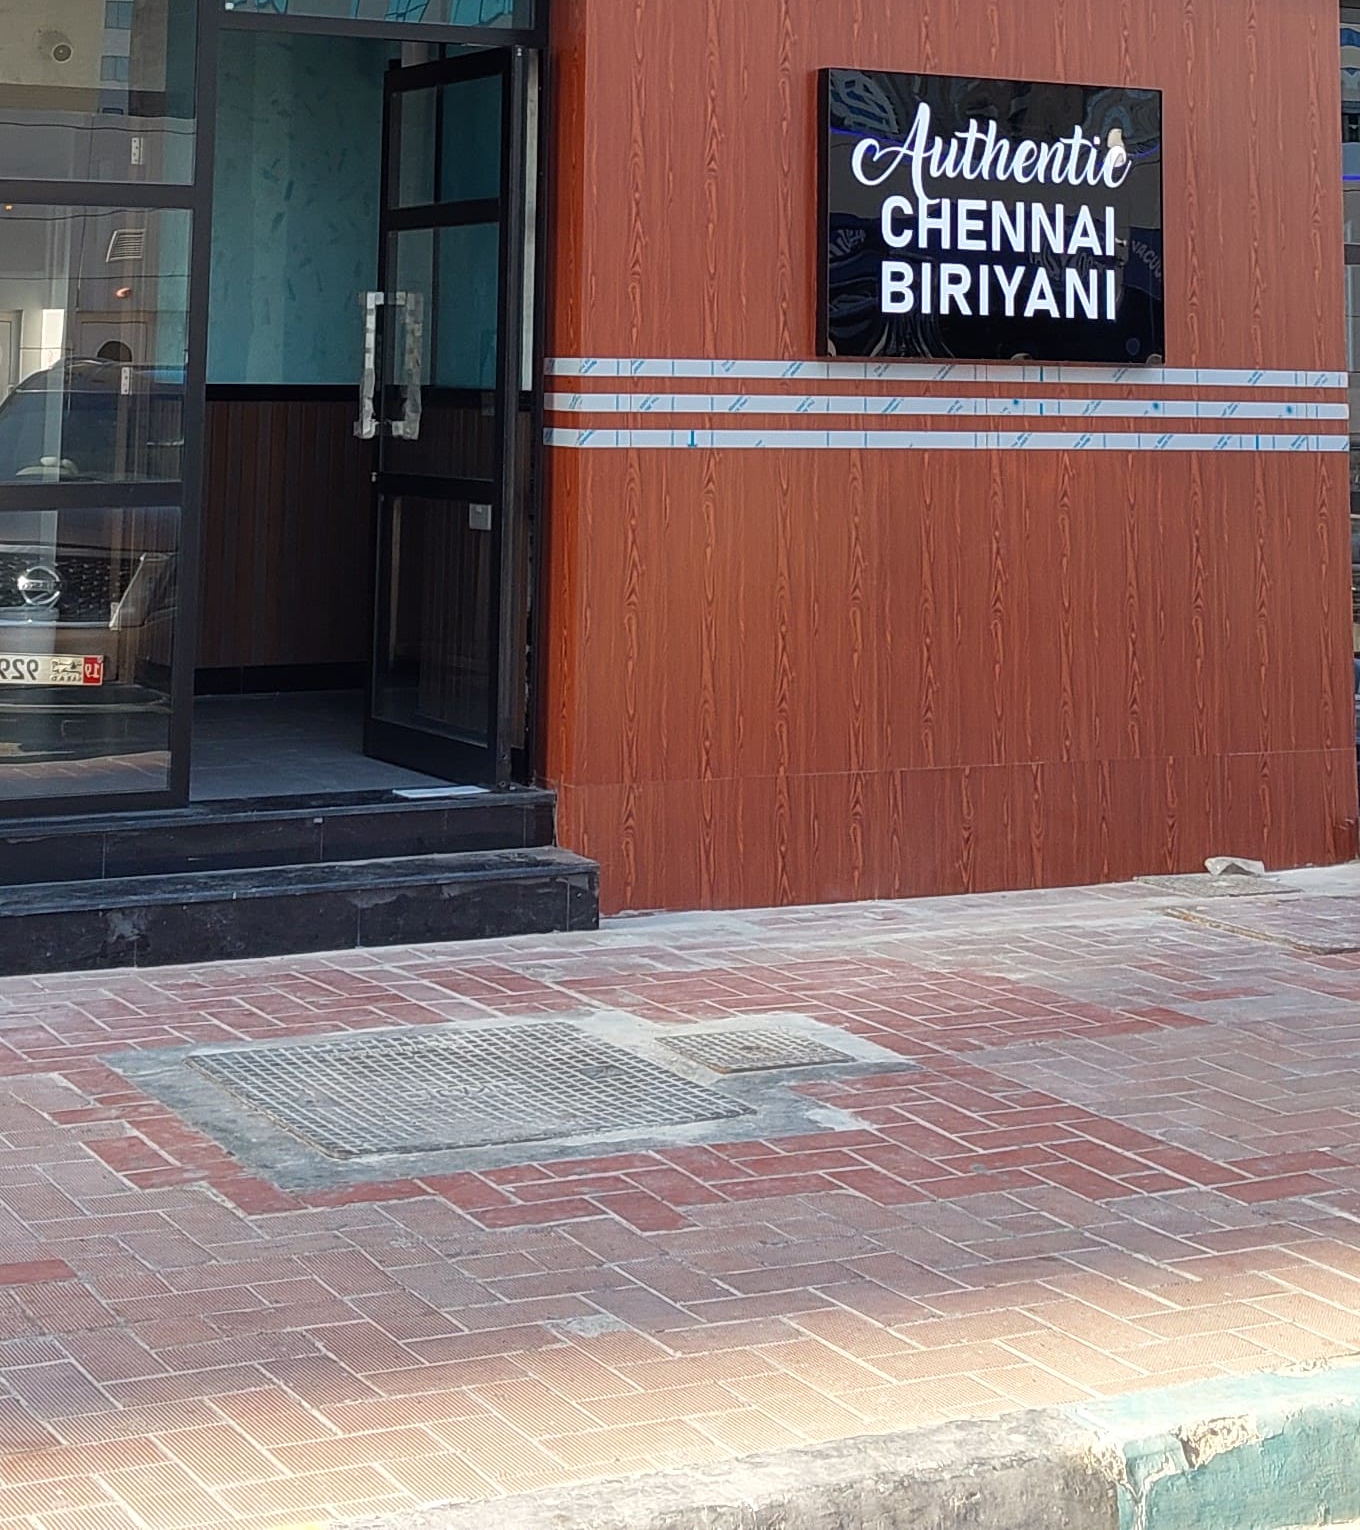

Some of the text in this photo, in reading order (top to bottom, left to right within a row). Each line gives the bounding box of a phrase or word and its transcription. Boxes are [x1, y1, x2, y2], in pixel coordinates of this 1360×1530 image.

[851, 102, 1134, 206] Authentic
[881, 195, 1116, 257] CHENNAI
[881, 261, 1117, 320] BIRIYANI
